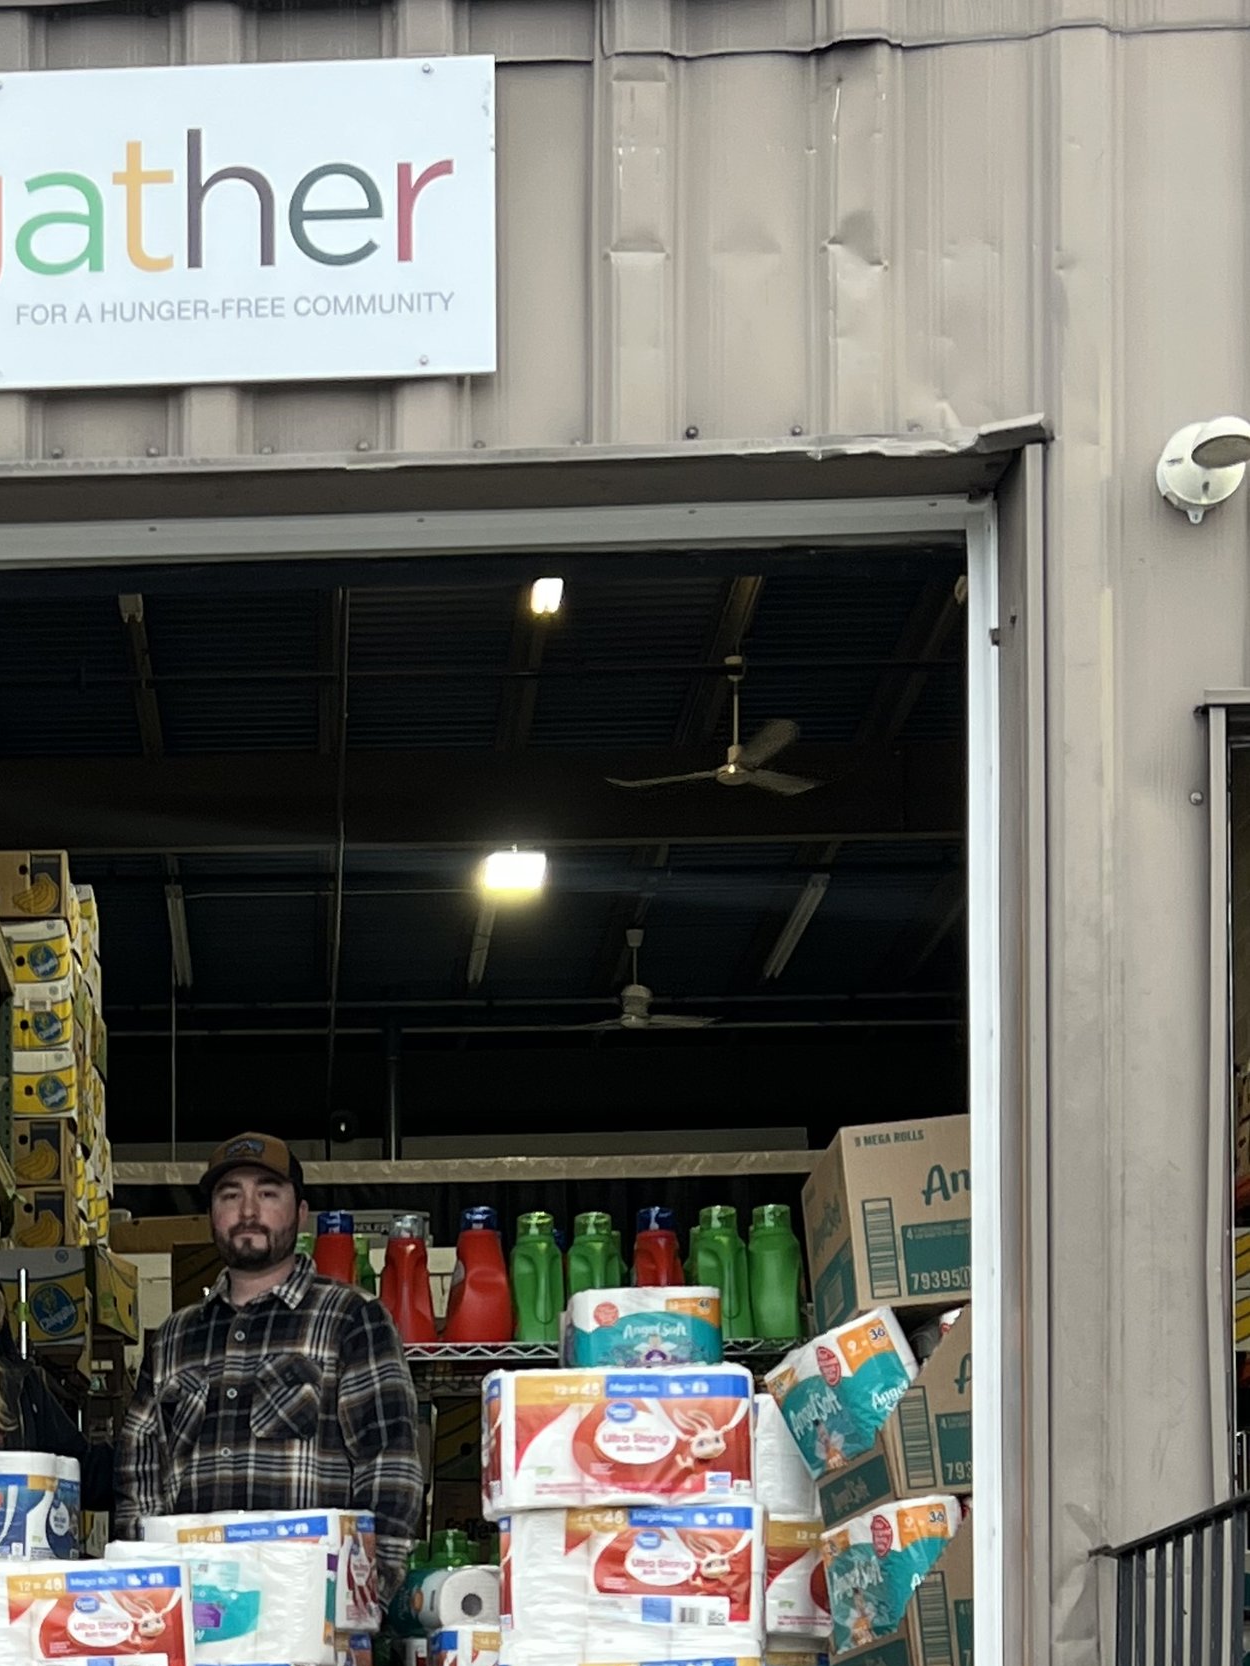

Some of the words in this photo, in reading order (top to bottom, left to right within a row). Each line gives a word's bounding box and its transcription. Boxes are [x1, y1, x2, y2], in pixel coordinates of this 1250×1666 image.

[16, 303, 70, 325] FOR
[75, 302, 92, 323] A
[101, 297, 286, 322] HUNGER-FREE
[294, 292, 454, 317] COMMUNITY
[863, 1133, 892, 1147] MEGA
[894, 1130, 925, 1143] ROLLS
[623, 1322, 661, 1339] Angel
[662, 1321, 688, 1337] Soft
[868, 1326, 886, 1341] 36
[603, 1433, 631, 1444] Ultra
[633, 1432, 670, 1446] Strong
[929, 1510, 945, 1524] 36
[631, 1558, 656, 1569] Ultra
[657, 1558, 691, 1571] Strong
[18, 1581, 31, 1592] 12
[44, 1578, 63, 1592] 48
[70, 1577, 96, 1588] Mega
[74, 1621, 96, 1631] Ultra
[98, 1619, 129, 1632] Strong
